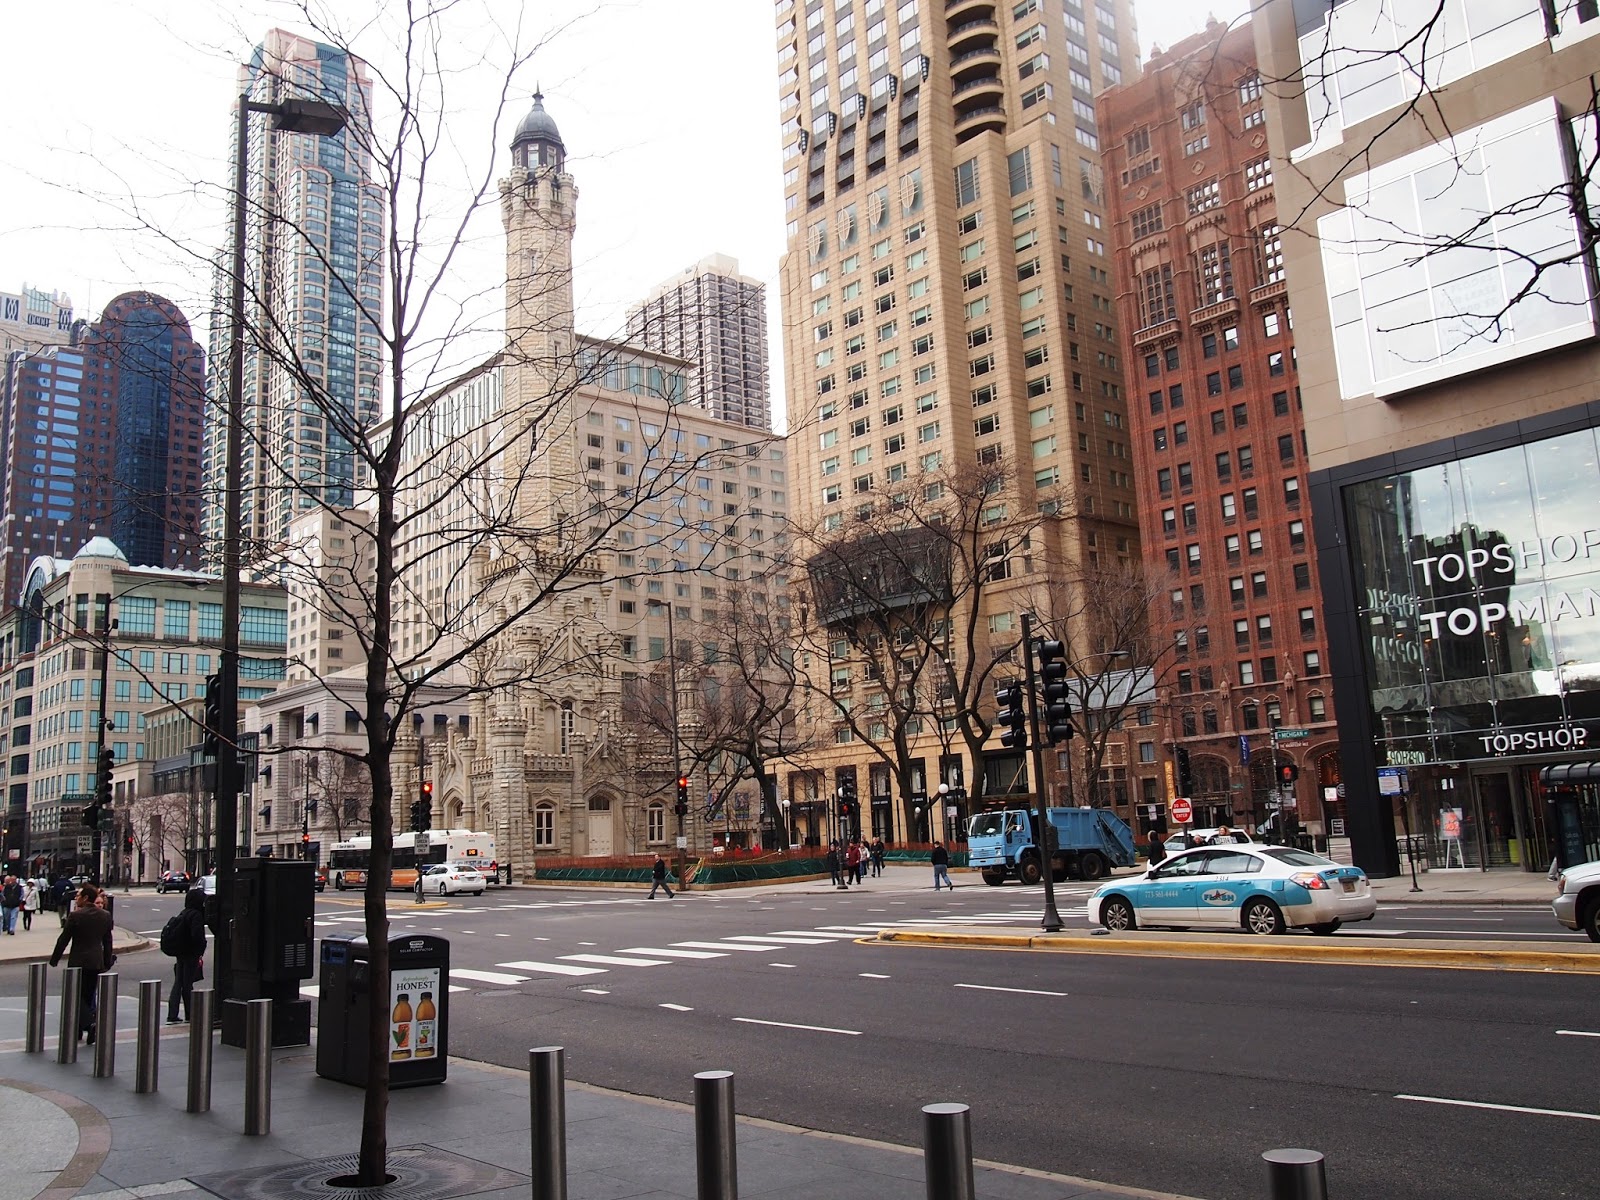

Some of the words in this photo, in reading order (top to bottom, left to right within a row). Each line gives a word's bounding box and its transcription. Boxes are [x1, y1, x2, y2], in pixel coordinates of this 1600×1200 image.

[1281, 731, 1304, 739] MICHIGAN
[1478, 727, 1588, 753] TOPSHOP
[1203, 890, 1235, 902] FLASH
[396, 980, 436, 991] HONEST
